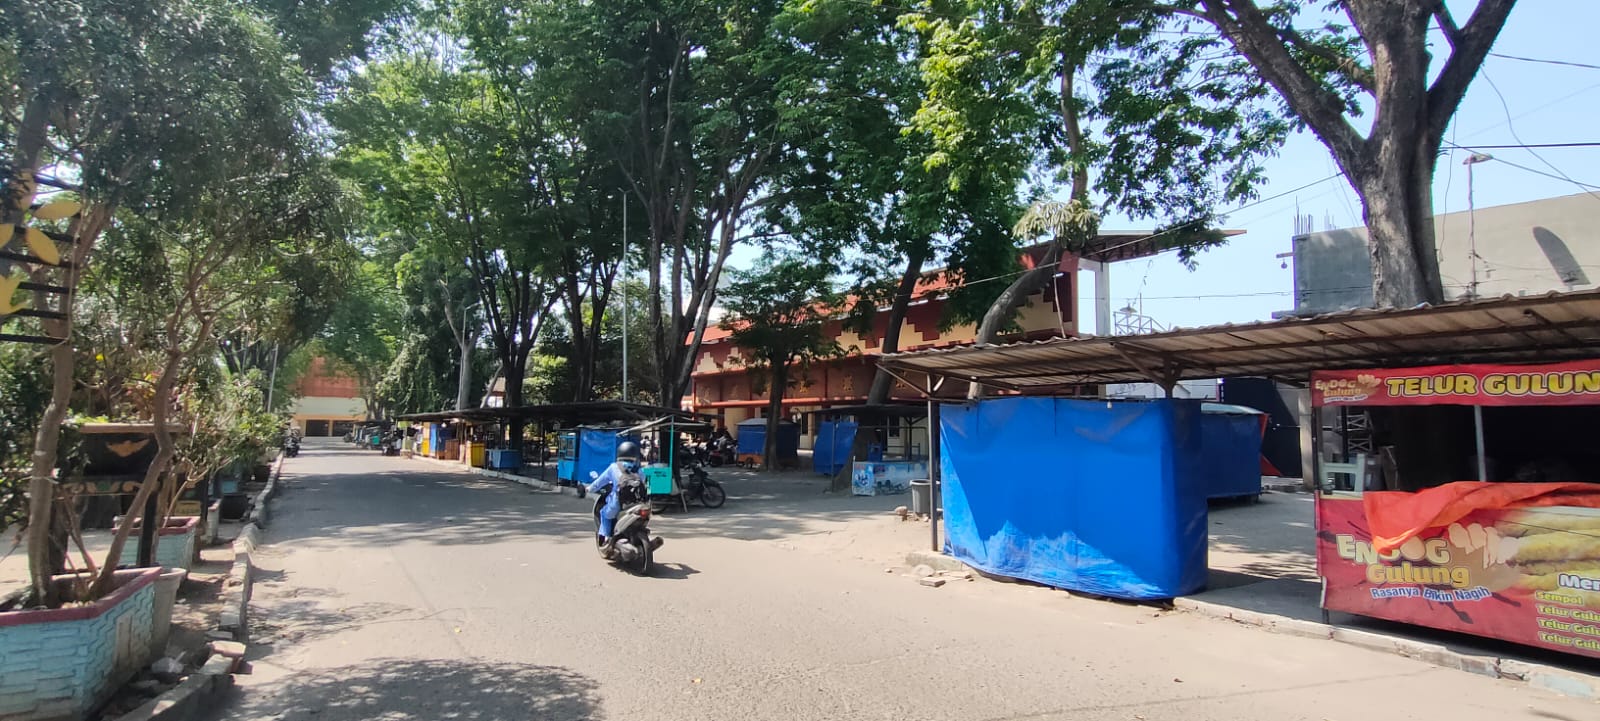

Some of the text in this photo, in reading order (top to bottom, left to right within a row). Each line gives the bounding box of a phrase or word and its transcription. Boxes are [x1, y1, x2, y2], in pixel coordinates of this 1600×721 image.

[1387, 372, 1600, 396] TELUR GULUN
[1367, 562, 1470, 588] Gulung
[1371, 587, 1491, 601] Rasanya Bikin Nagih
[1536, 592, 1583, 604] Sempol
[1538, 605, 1569, 616] Telur
[1539, 619, 1571, 630] Telur
[1541, 633, 1572, 644] Telur
